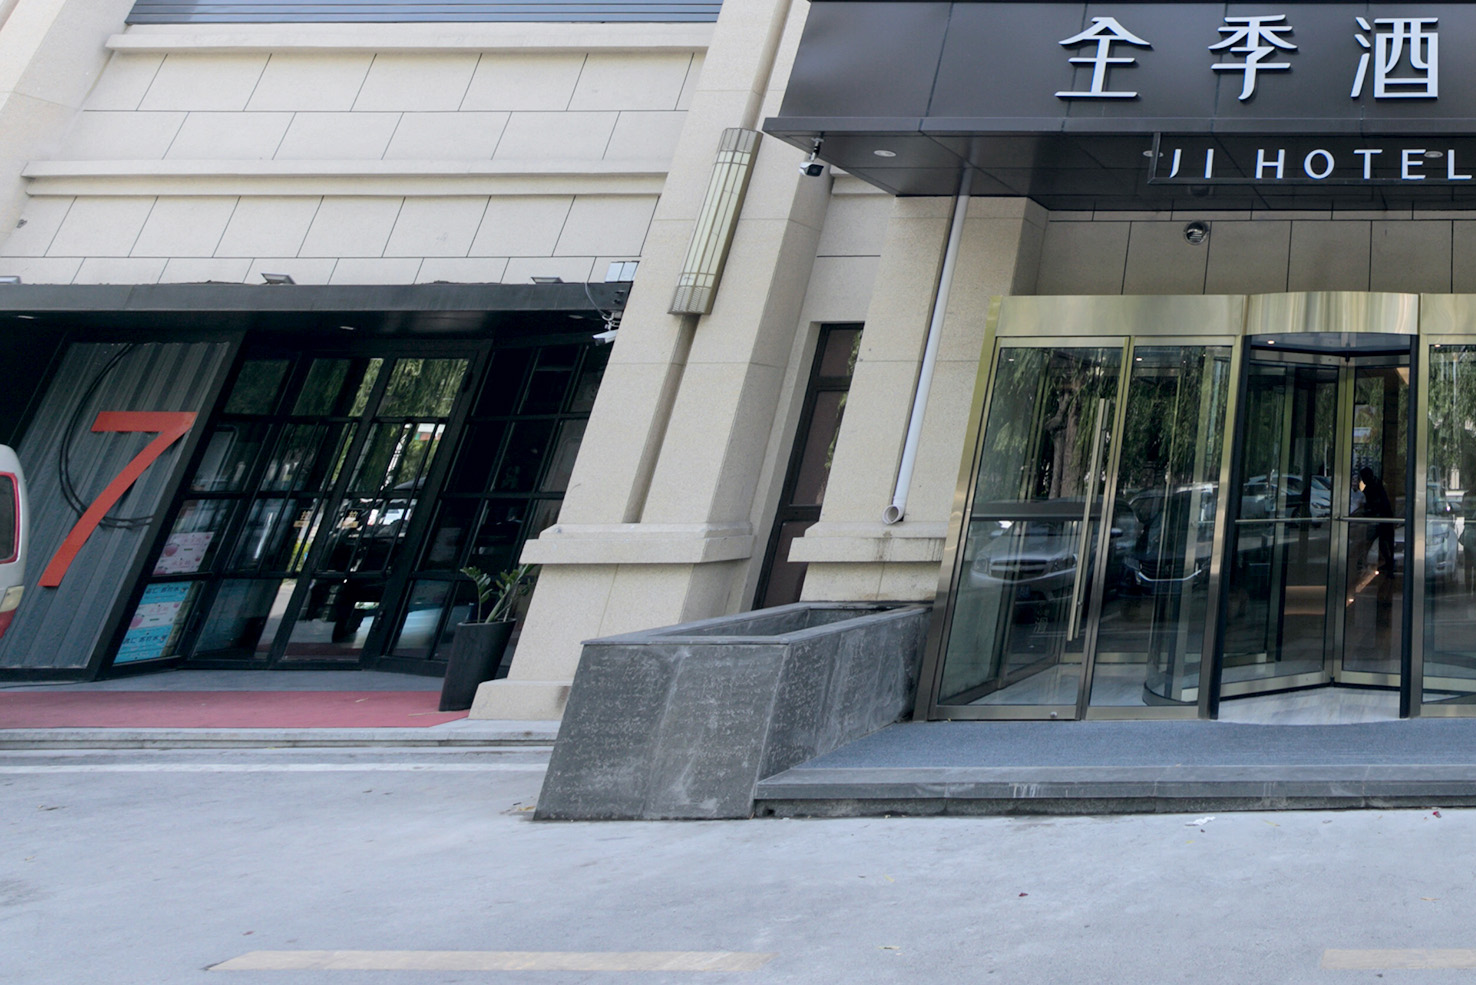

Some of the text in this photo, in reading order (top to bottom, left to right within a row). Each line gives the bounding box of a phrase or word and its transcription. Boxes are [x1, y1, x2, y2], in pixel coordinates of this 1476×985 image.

[1168, 147, 1473, 180] JI HOTEL
[37, 411, 199, 588] 7
